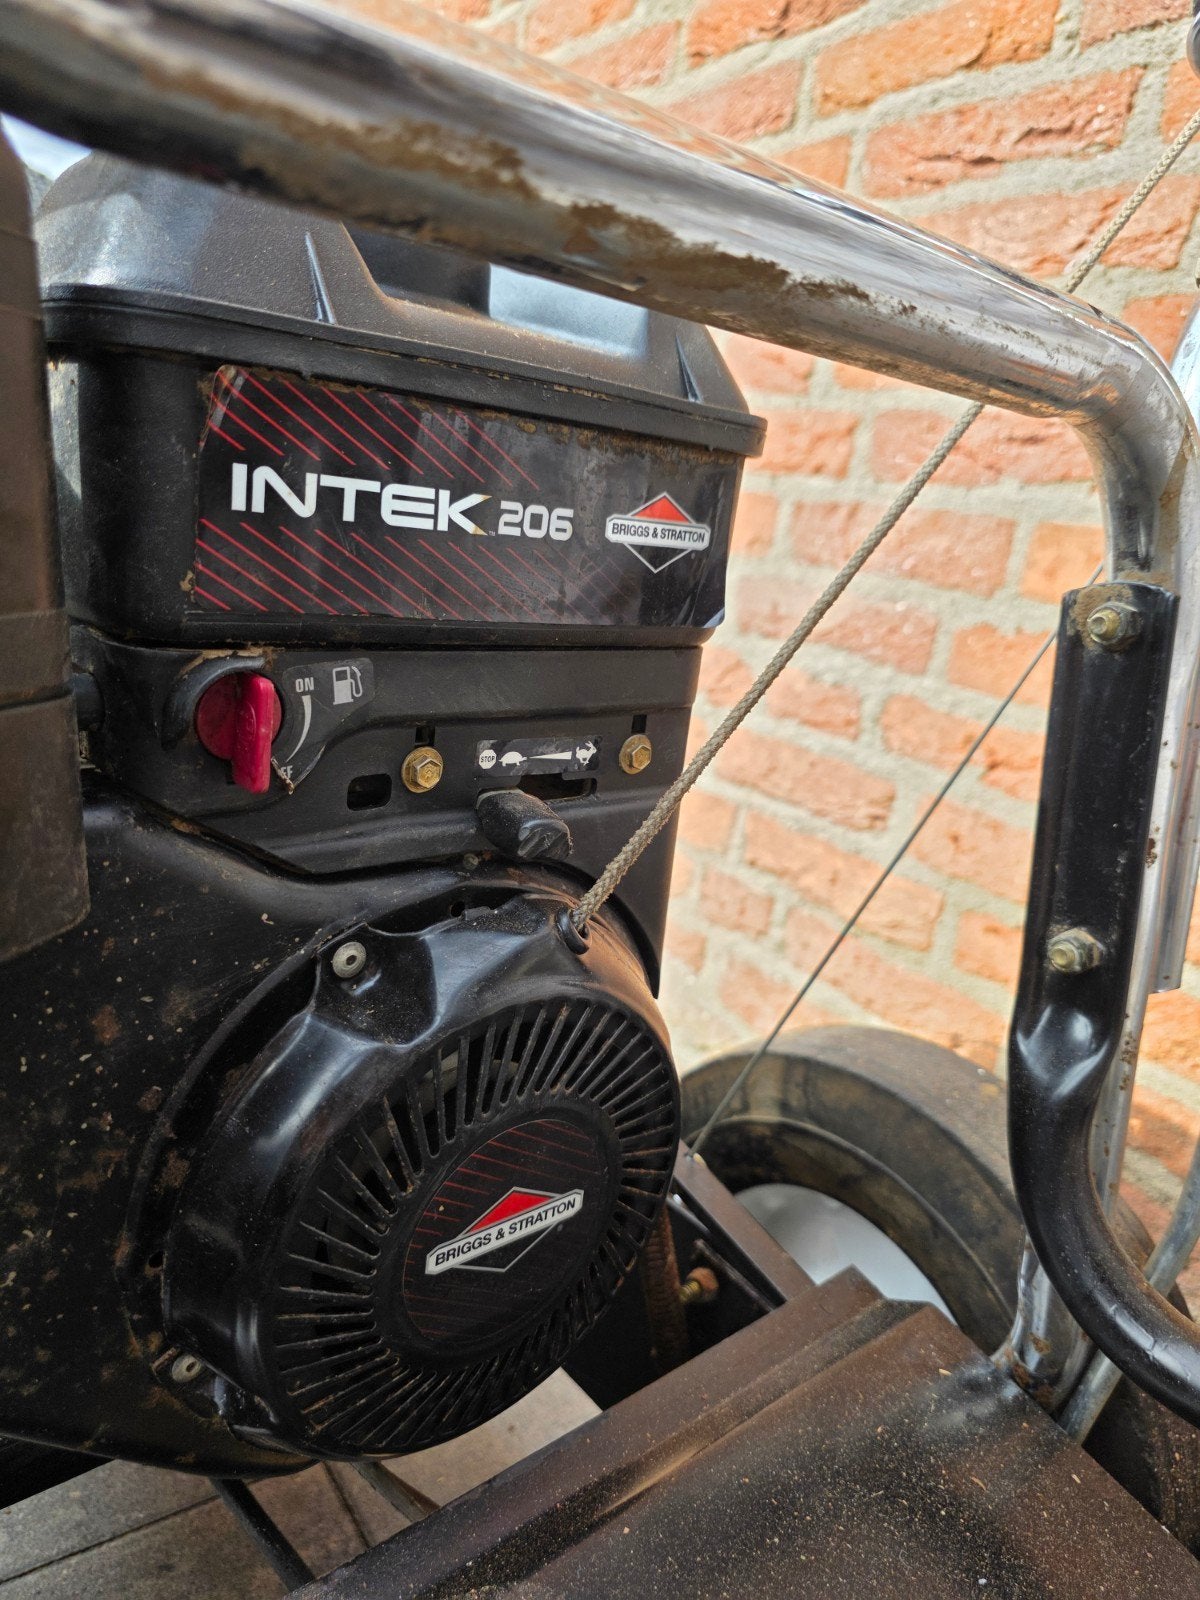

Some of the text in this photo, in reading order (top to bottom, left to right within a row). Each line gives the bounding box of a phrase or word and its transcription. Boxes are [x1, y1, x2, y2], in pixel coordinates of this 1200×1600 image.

[231, 462, 574, 541] INTEK 206
[612, 523, 705, 543] BRIGGS & STRATTON
[295, 677, 314, 692] ON
[480, 755, 496, 763] STOP
[435, 1198, 576, 1266] BRIGGS & STRATTON
